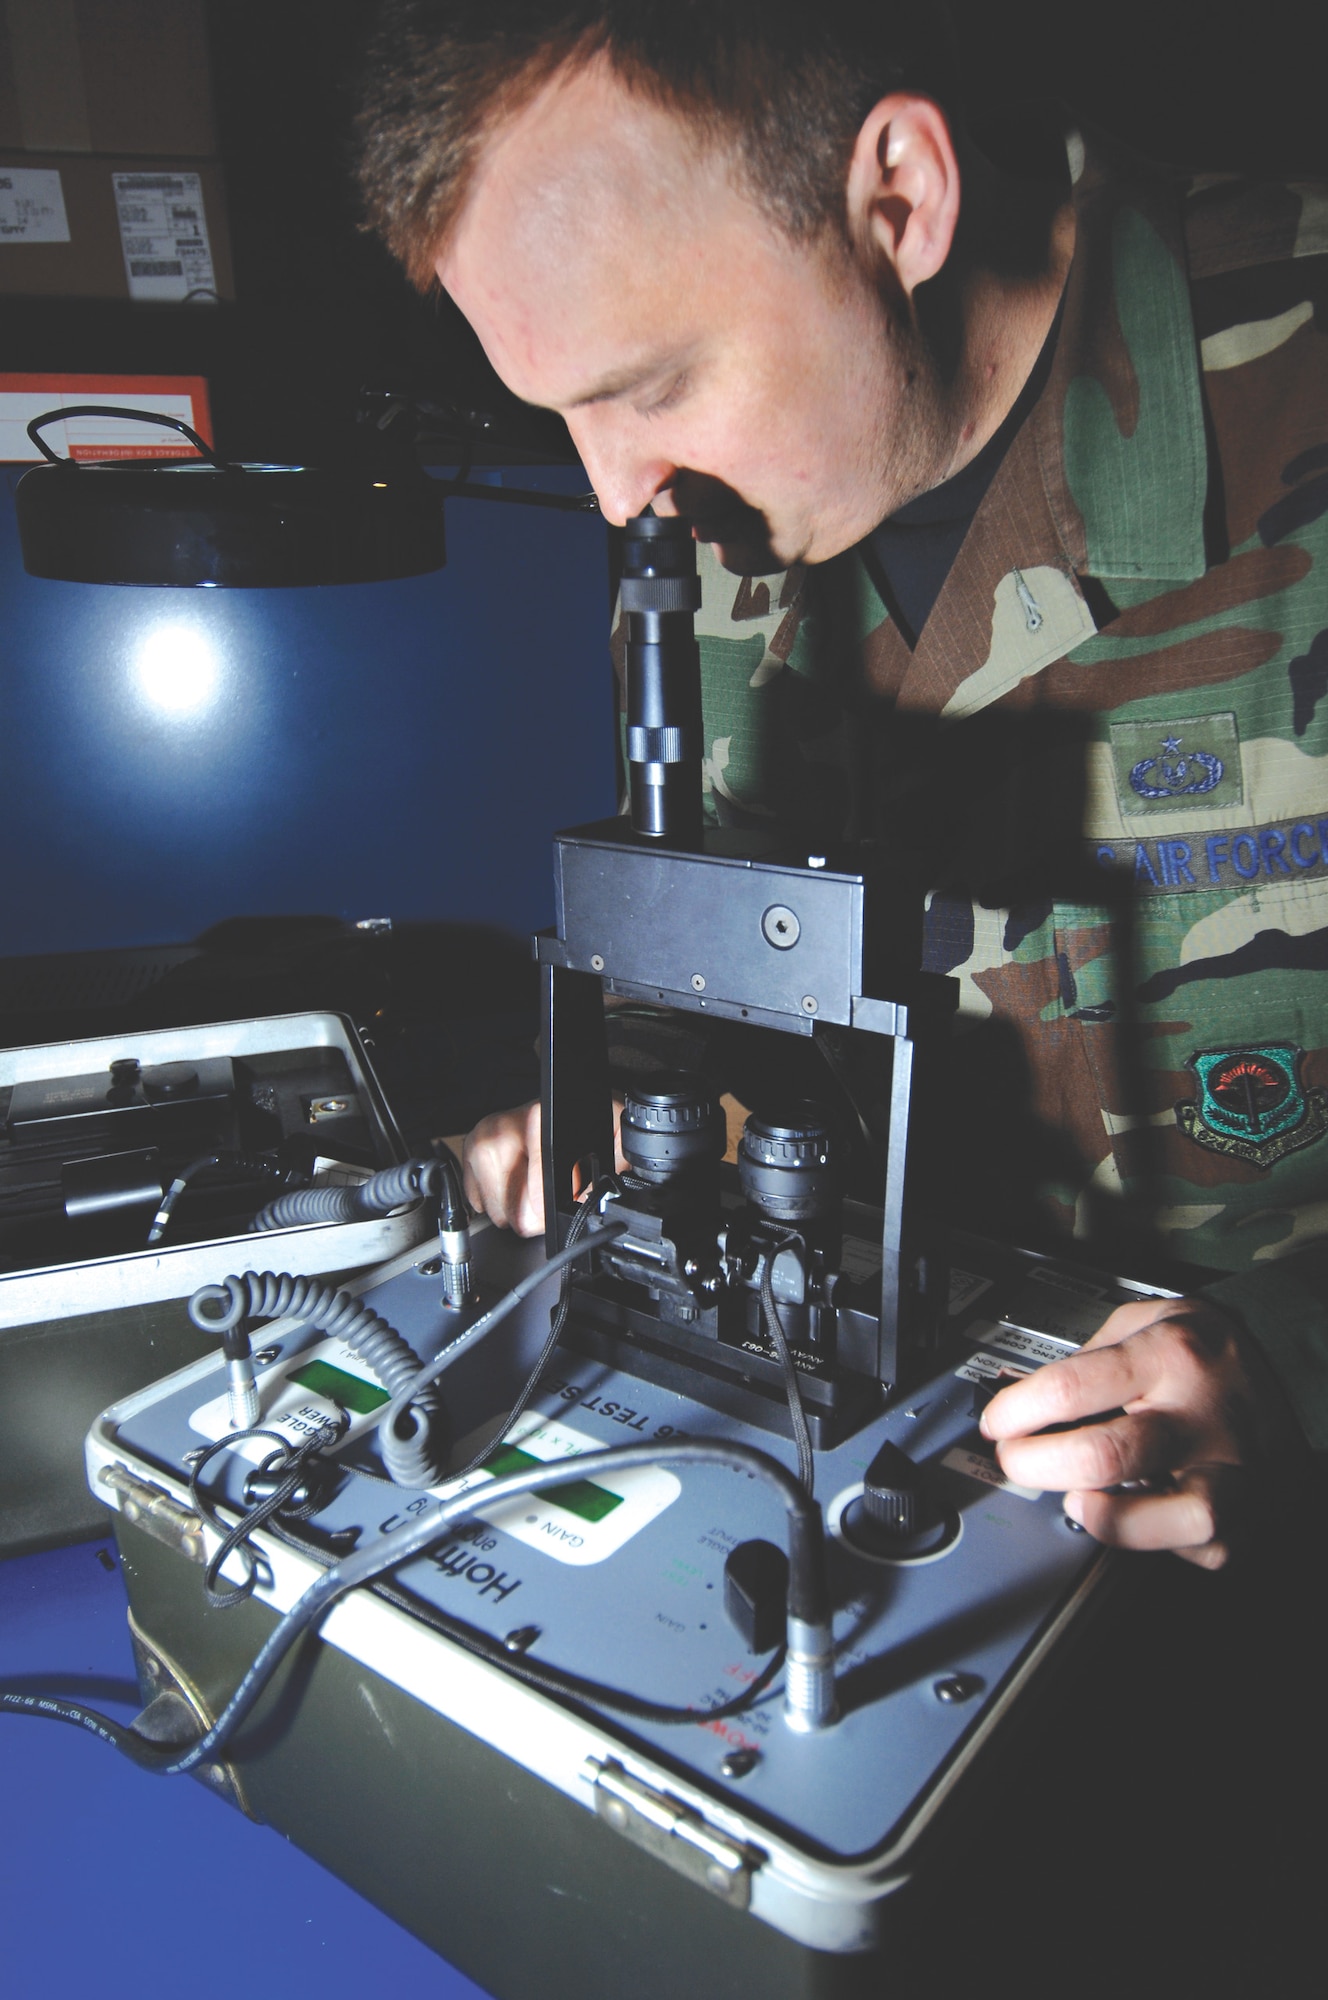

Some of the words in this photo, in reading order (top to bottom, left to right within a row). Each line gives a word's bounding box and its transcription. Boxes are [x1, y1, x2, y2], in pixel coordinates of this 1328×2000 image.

[136, 449, 153, 458] BOX
[1134, 840, 1197, 888] AIR
[276, 1413, 314, 1437] GGLE
[298, 1406, 341, 1430] OWER
[582, 1395, 651, 1432] TEST
[541, 1522, 585, 1548] GAIN
